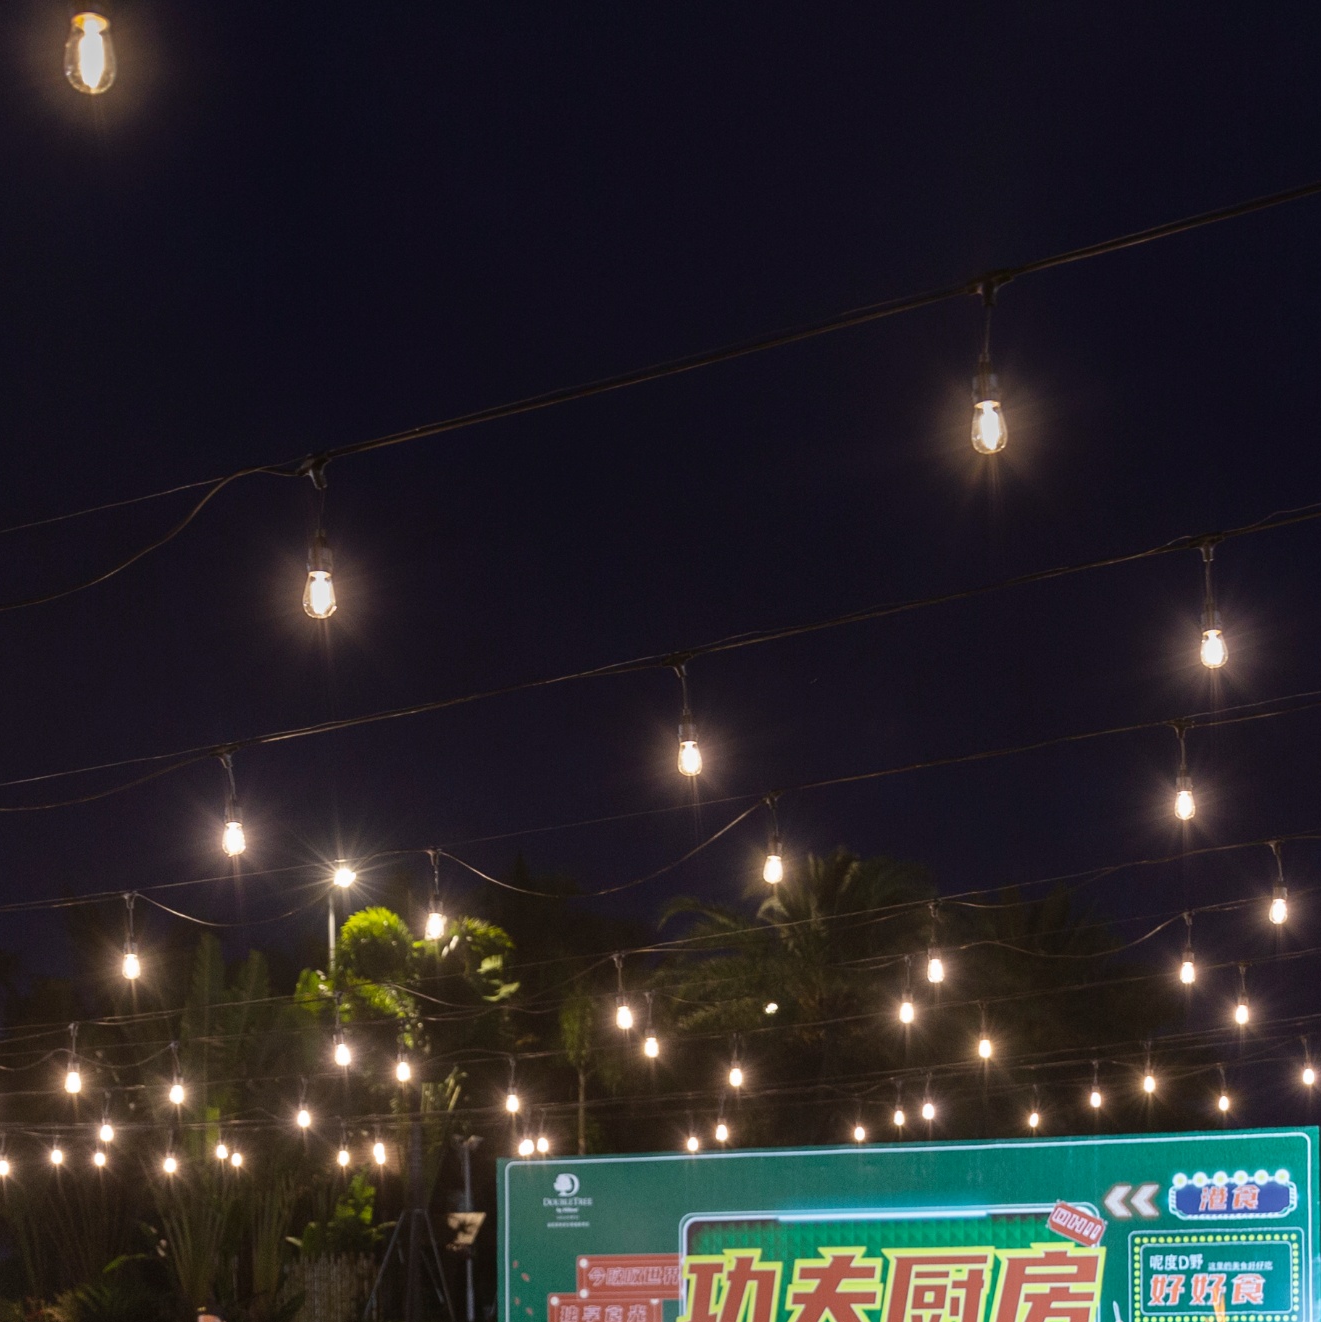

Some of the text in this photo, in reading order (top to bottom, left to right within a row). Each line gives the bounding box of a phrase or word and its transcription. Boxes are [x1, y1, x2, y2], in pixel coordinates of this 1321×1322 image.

[1198, 1185, 1261, 1212] 港食
[1149, 1254, 1204, 1271] 呢度D野
[1147, 1273, 1266, 1306] 好好食
